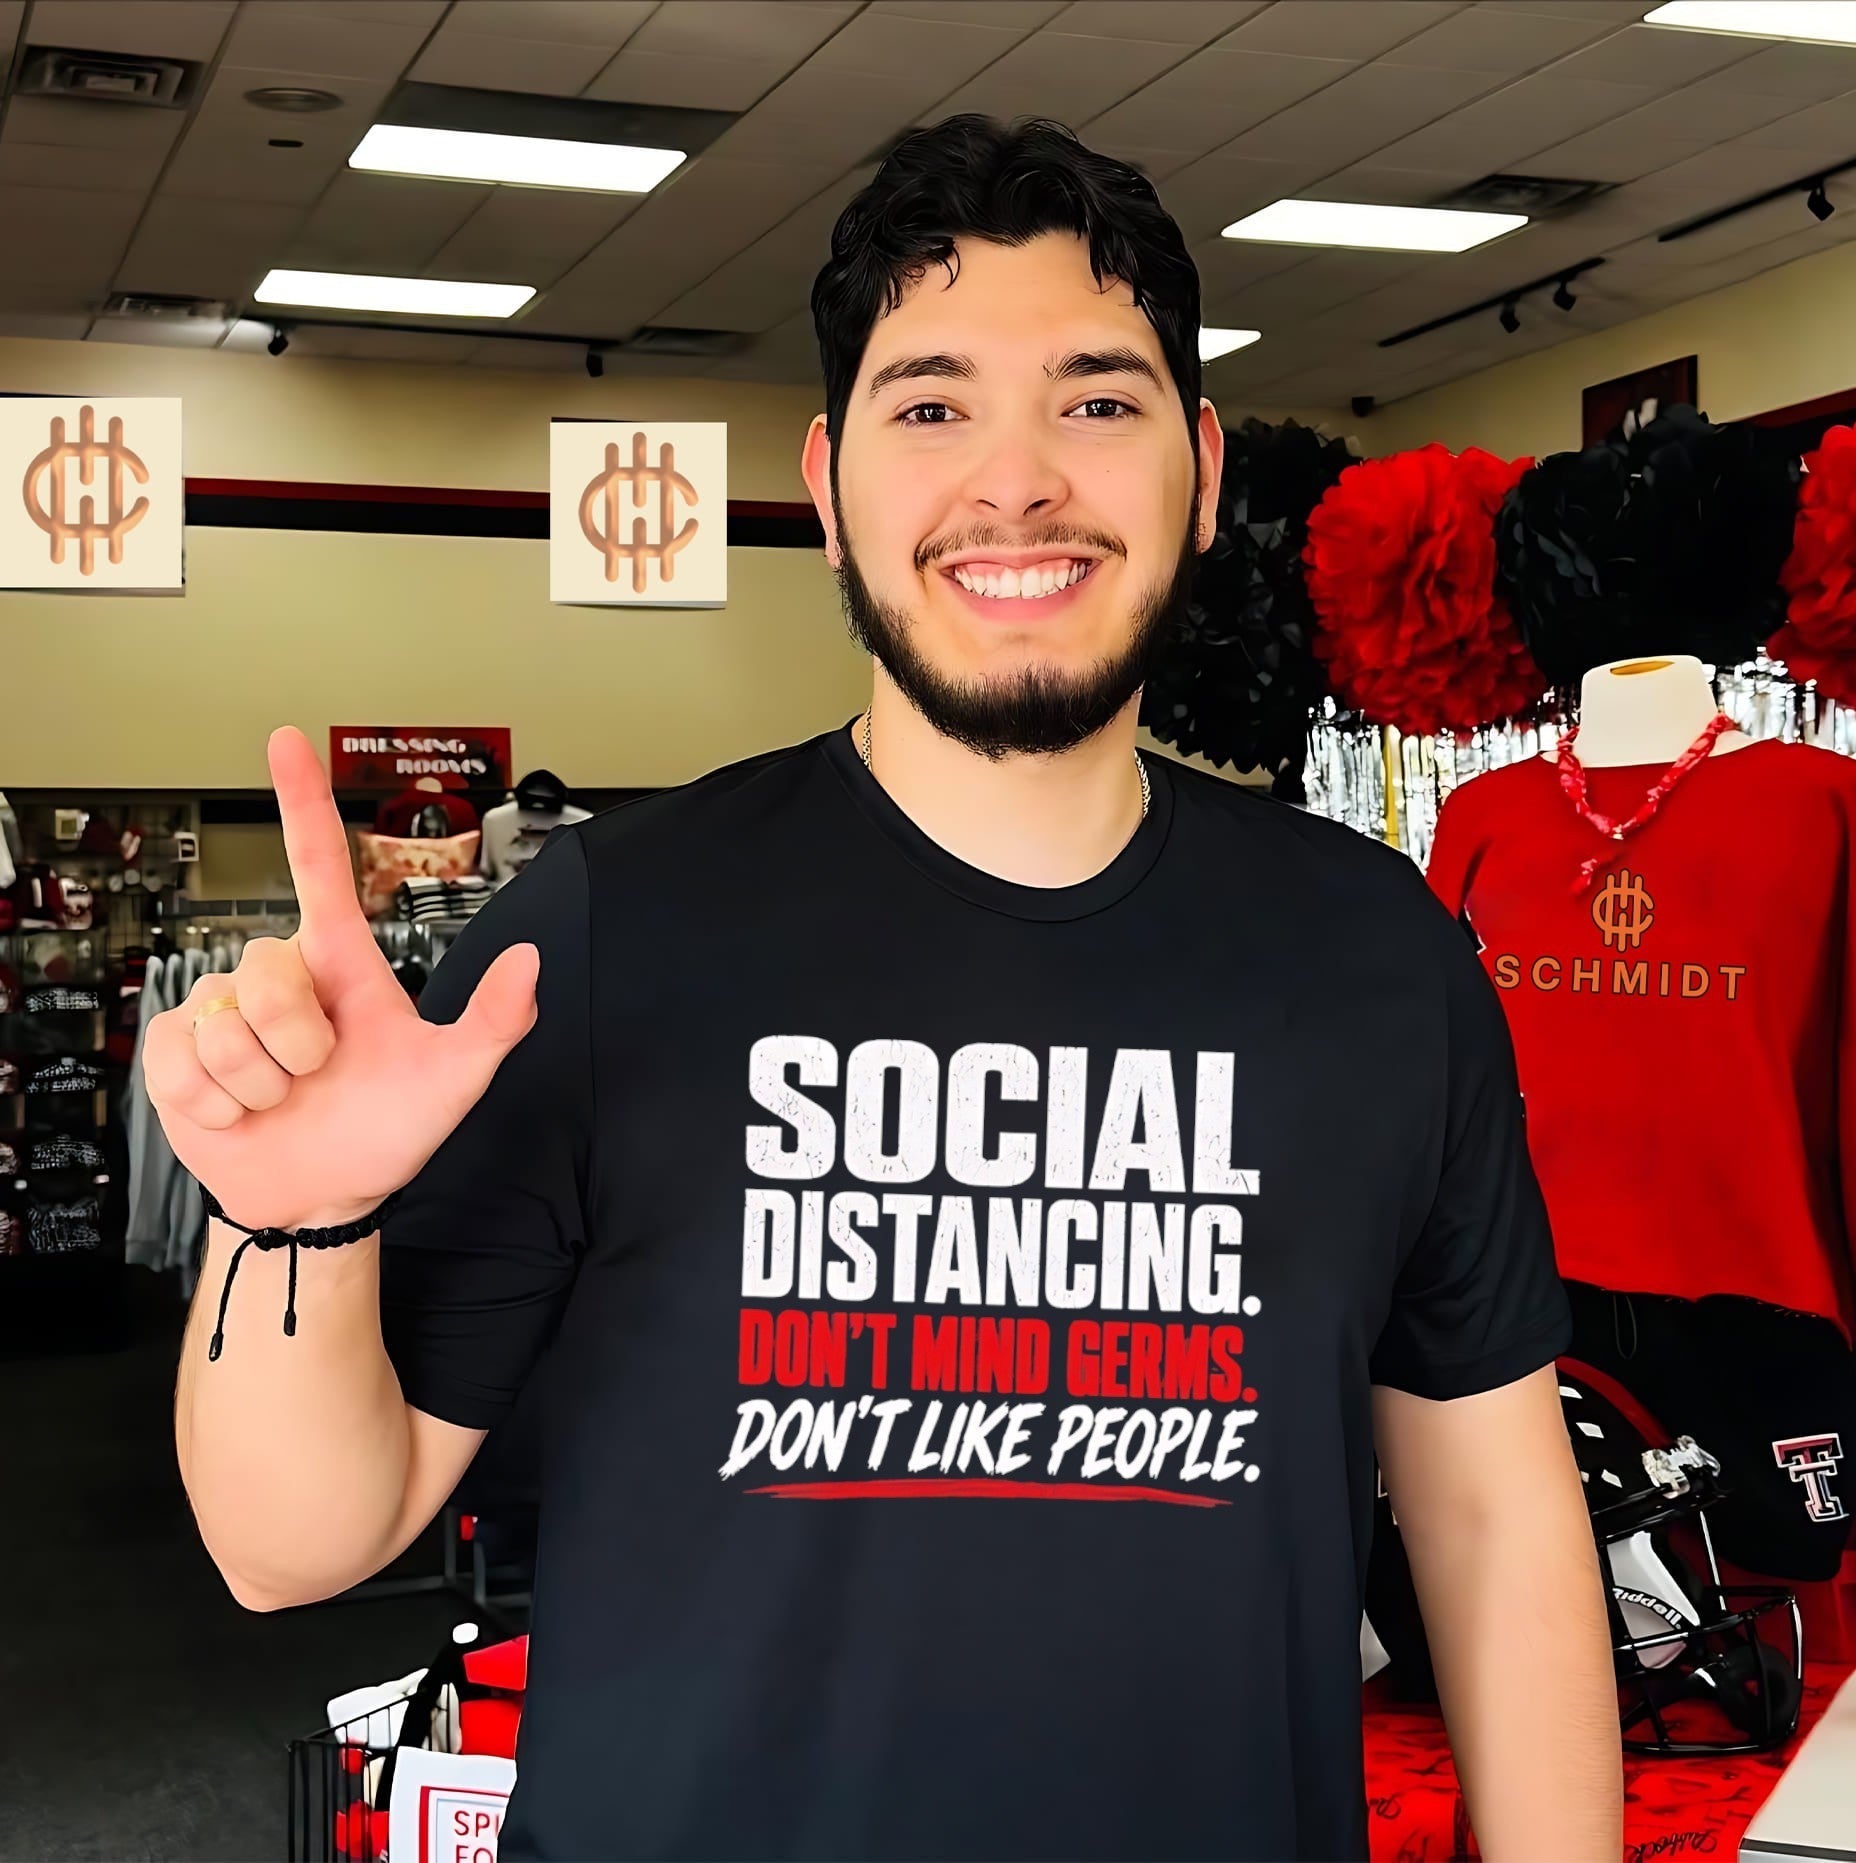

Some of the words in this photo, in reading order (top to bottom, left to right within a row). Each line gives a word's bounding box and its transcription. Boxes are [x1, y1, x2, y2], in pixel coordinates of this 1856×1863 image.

[342, 737, 466, 754] DRESSING
[396, 758, 487, 775] ROOMS
[1494, 953, 1746, 1000] SCHMIDT
[745, 1034, 1260, 1195] SOCIAL
[741, 1188, 1261, 1315] DISTANCING.
[738, 1308, 896, 1389] DON'T
[910, 1313, 1050, 1394] MIND
[1066, 1319, 1258, 1402] GERMS.
[718, 1395, 912, 1481] DON'T
[907, 1400, 1046, 1477] LIKE
[1047, 1403, 1261, 1482] PEOPLE.
